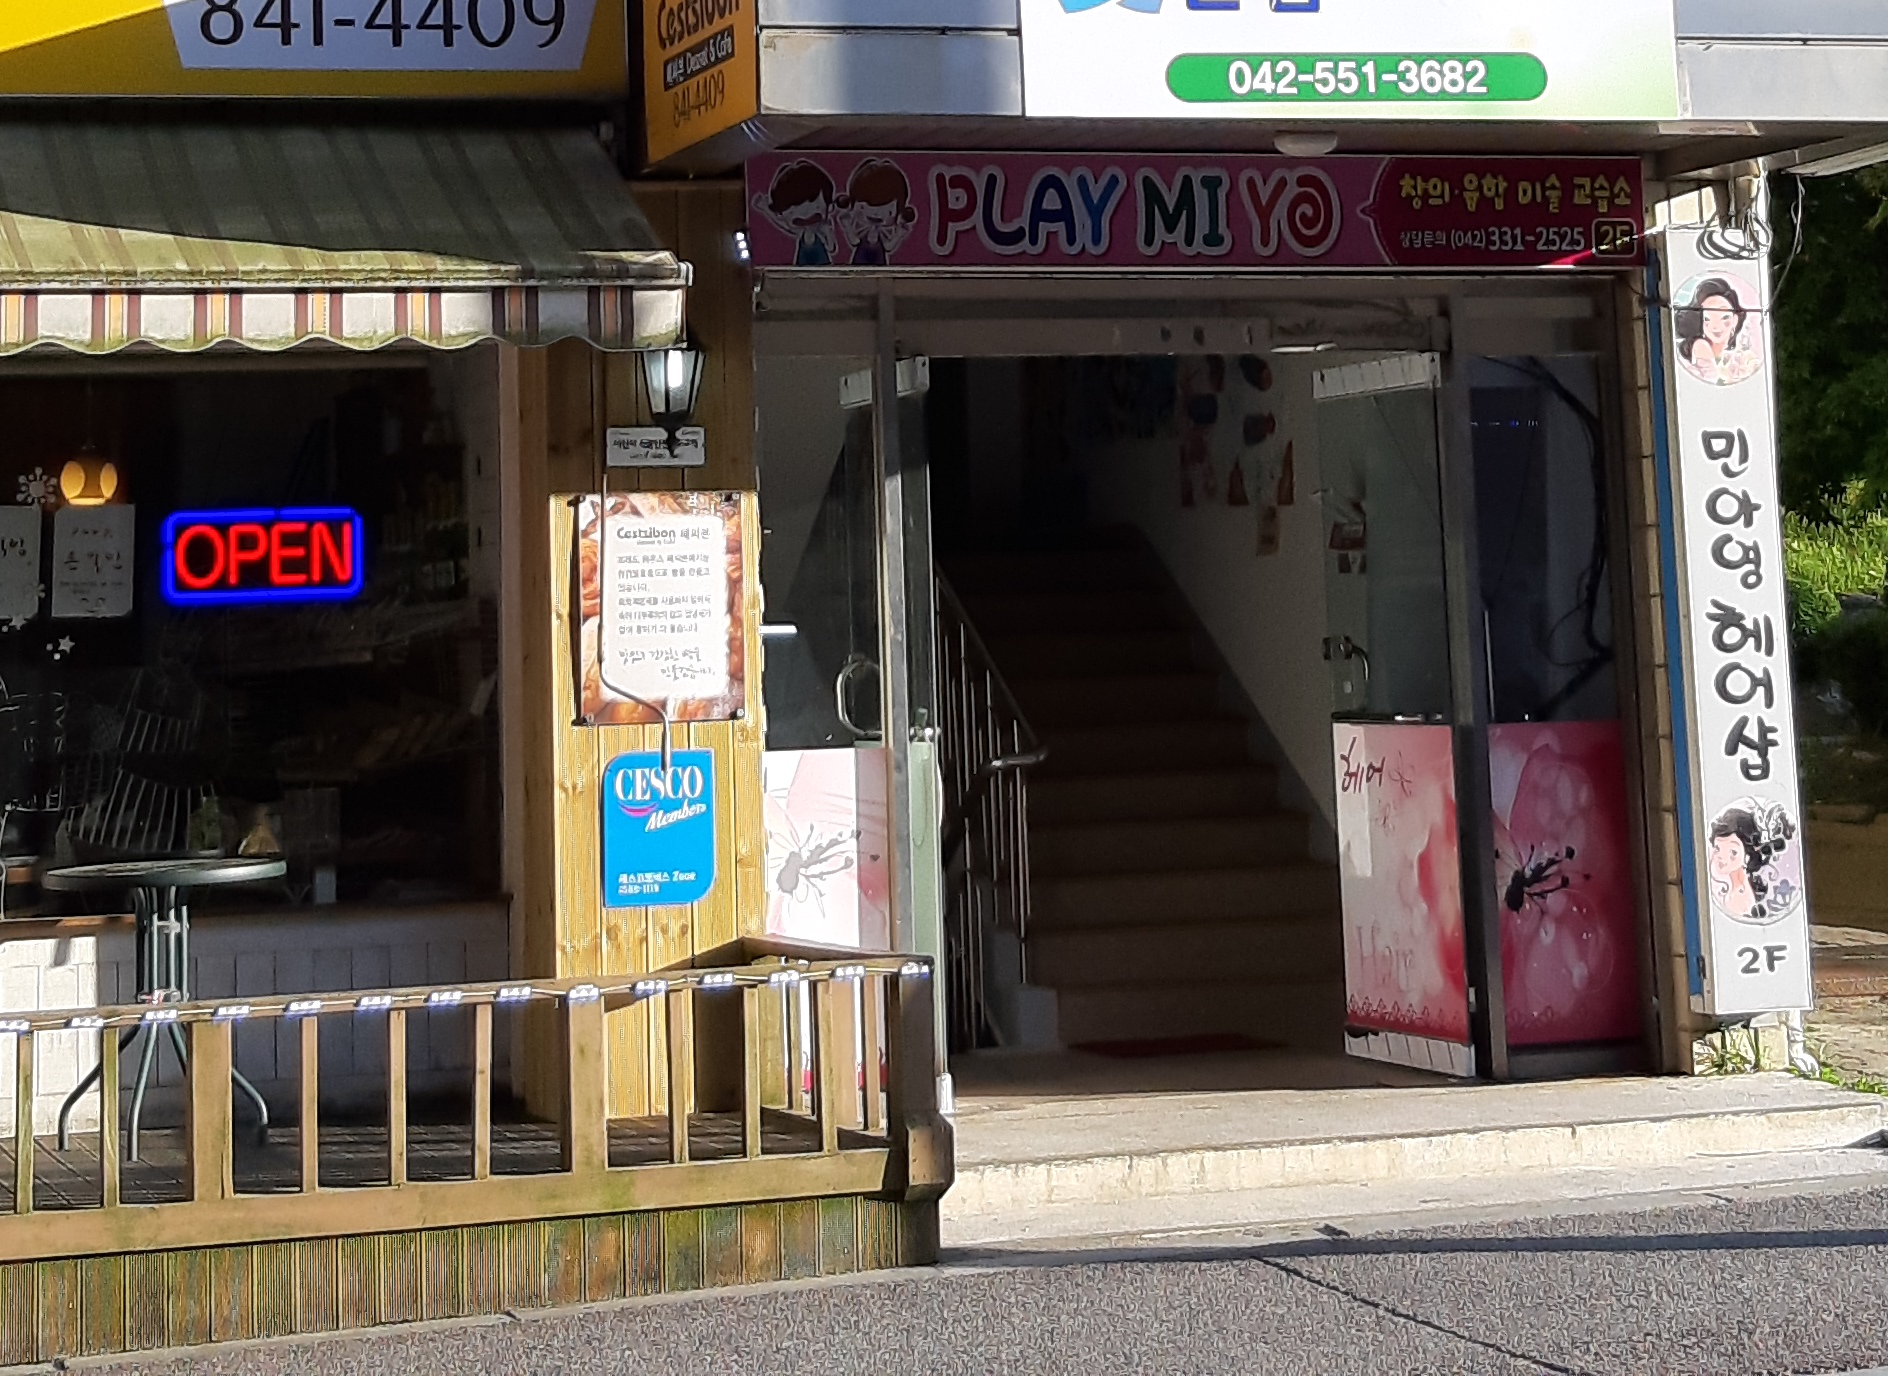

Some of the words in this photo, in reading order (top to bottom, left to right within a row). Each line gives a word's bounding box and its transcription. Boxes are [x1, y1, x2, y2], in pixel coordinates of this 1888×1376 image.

[1228, 59, 1487, 98] 042-551-3682
[935, 172, 1120, 248] PLAY
[1143, 175, 1224, 248] MI
[1246, 173, 1324, 248] YO
[1400, 174, 1508, 212] 창의·융합
[1518, 174, 1562, 214] 미술
[1573, 175, 1632, 213] 교습소
[175, 521, 353, 589] OPEN
[615, 766, 704, 801] CESCO
[1736, 944, 1788, 975] 2F
